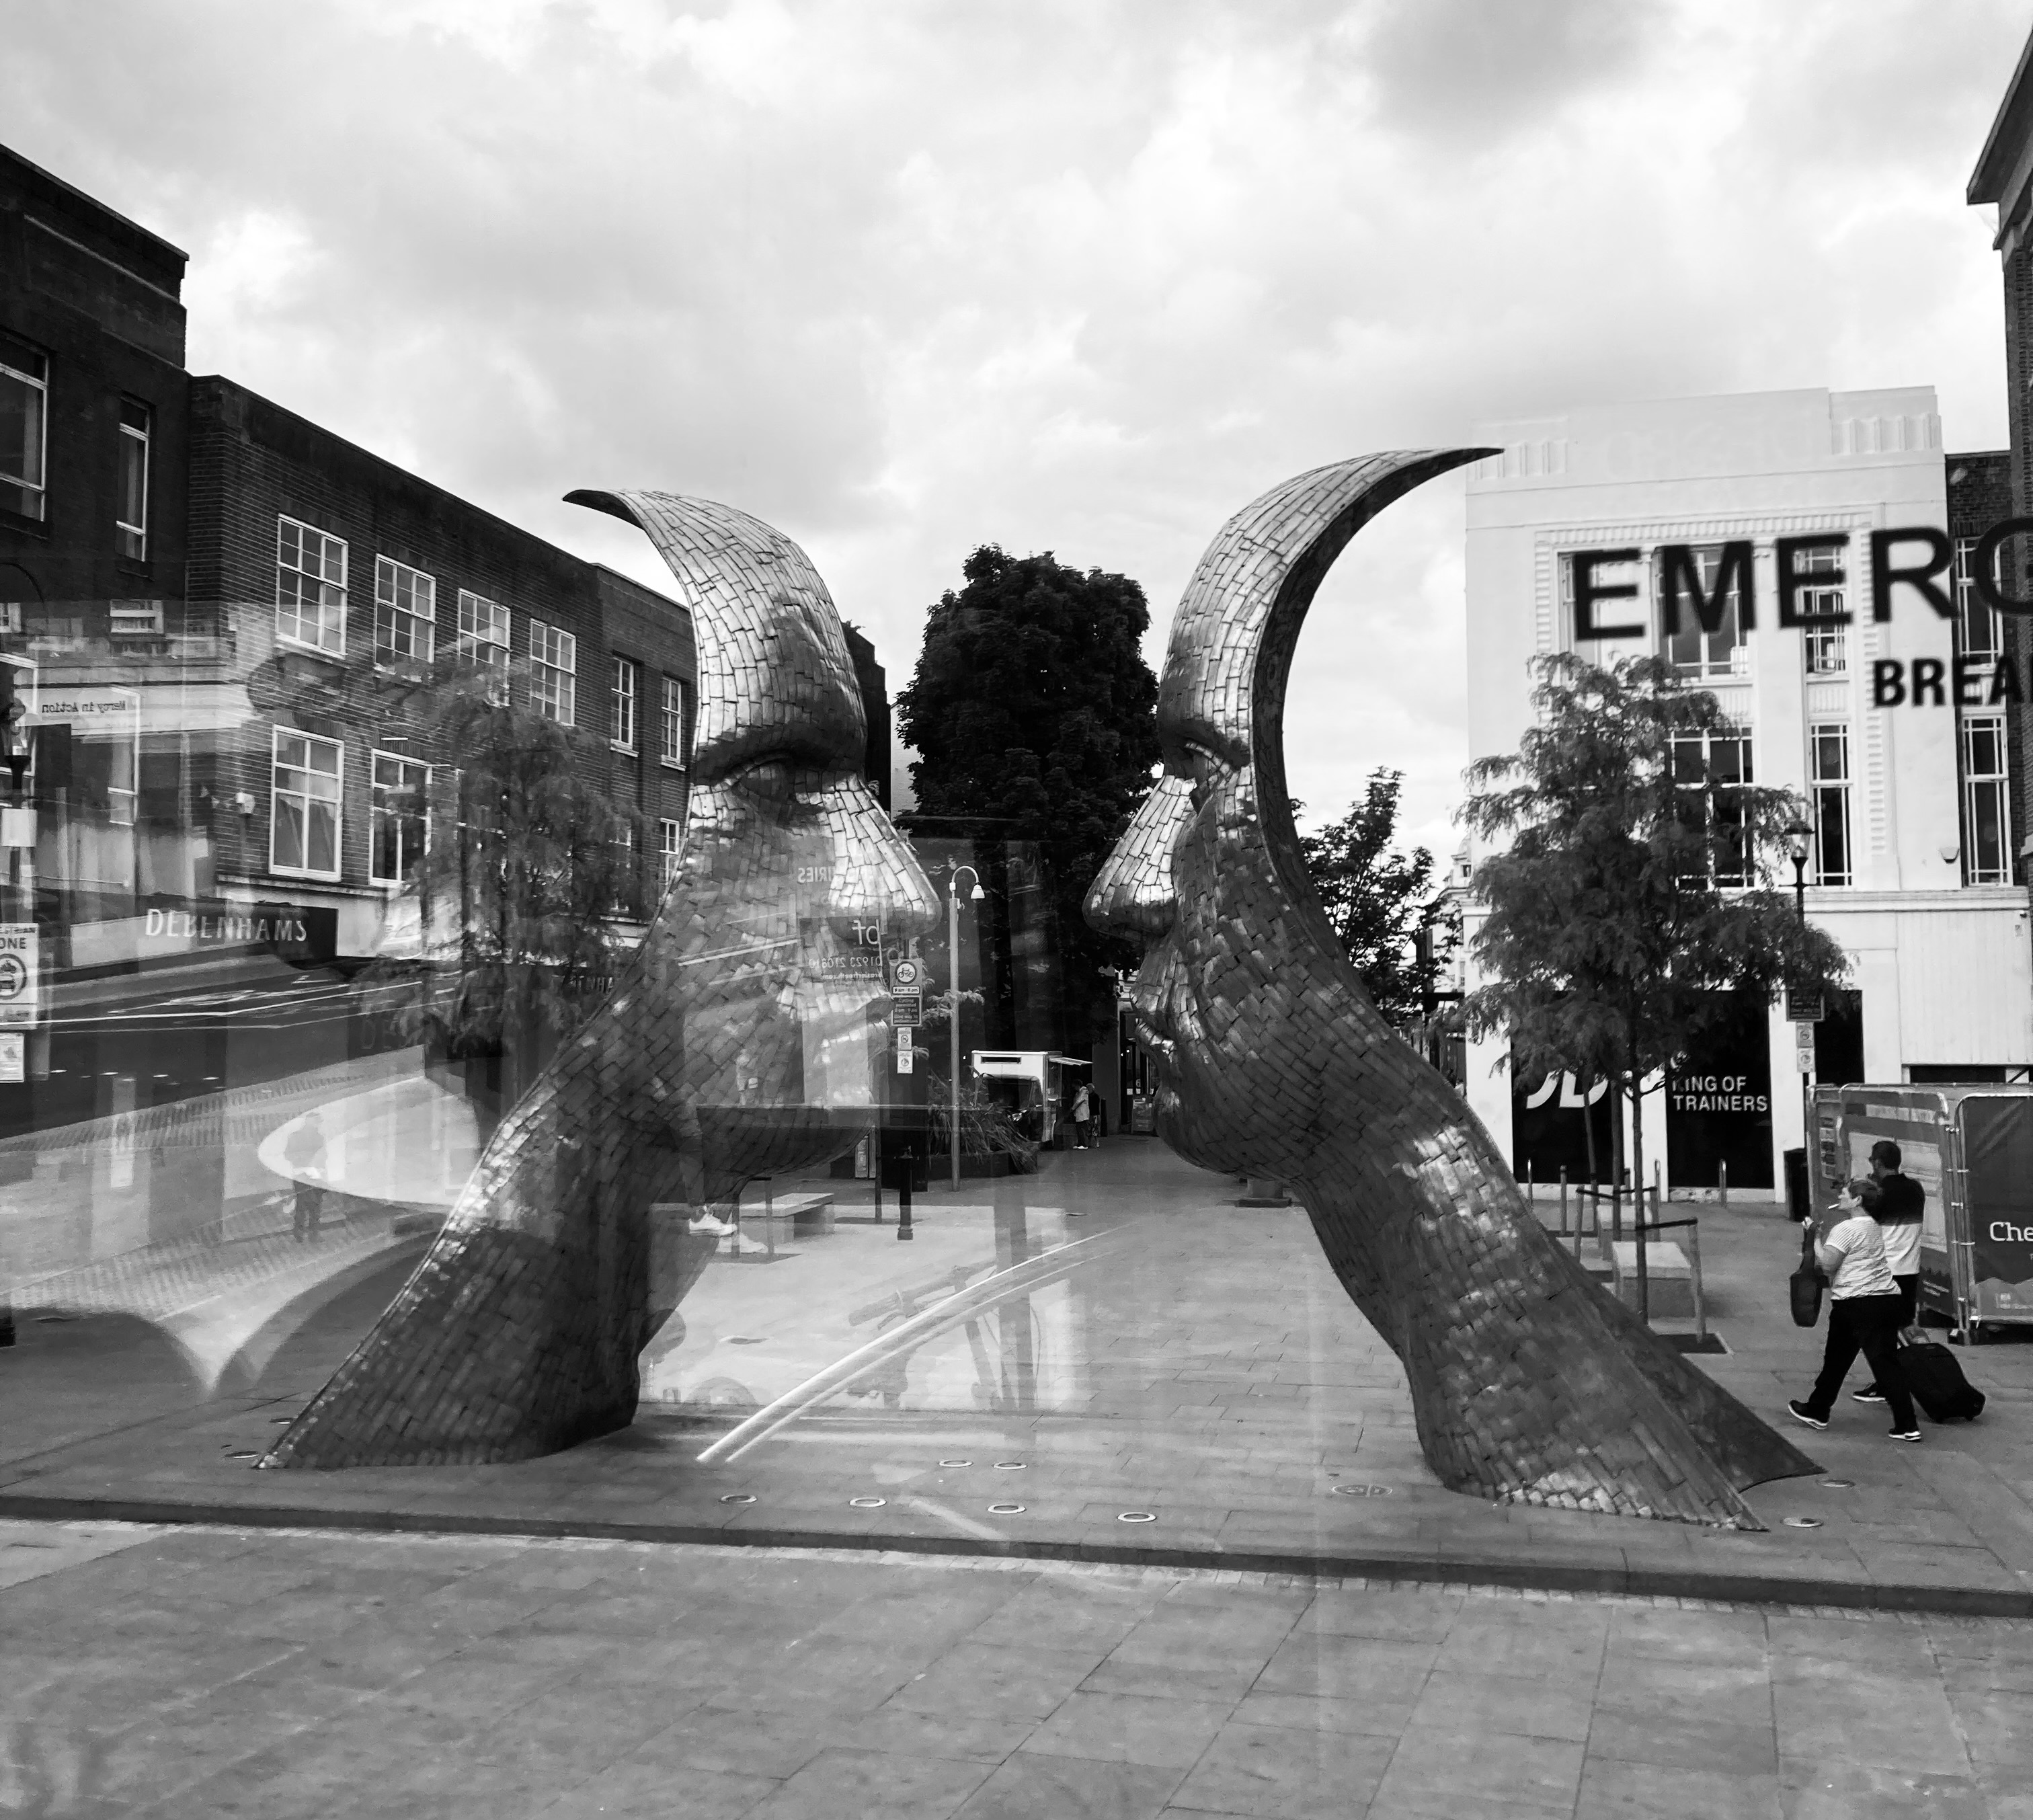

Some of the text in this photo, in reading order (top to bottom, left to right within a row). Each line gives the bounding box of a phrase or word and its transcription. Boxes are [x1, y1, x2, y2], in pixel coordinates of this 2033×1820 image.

[1874, 656, 2033, 707] BREA
[145, 908, 307, 941] DEBENHAMS
[1722, 1076, 1747, 1092] OF
[1673, 1095, 1768, 1111] TRAINERS
[1990, 1221, 2033, 1241] Che
